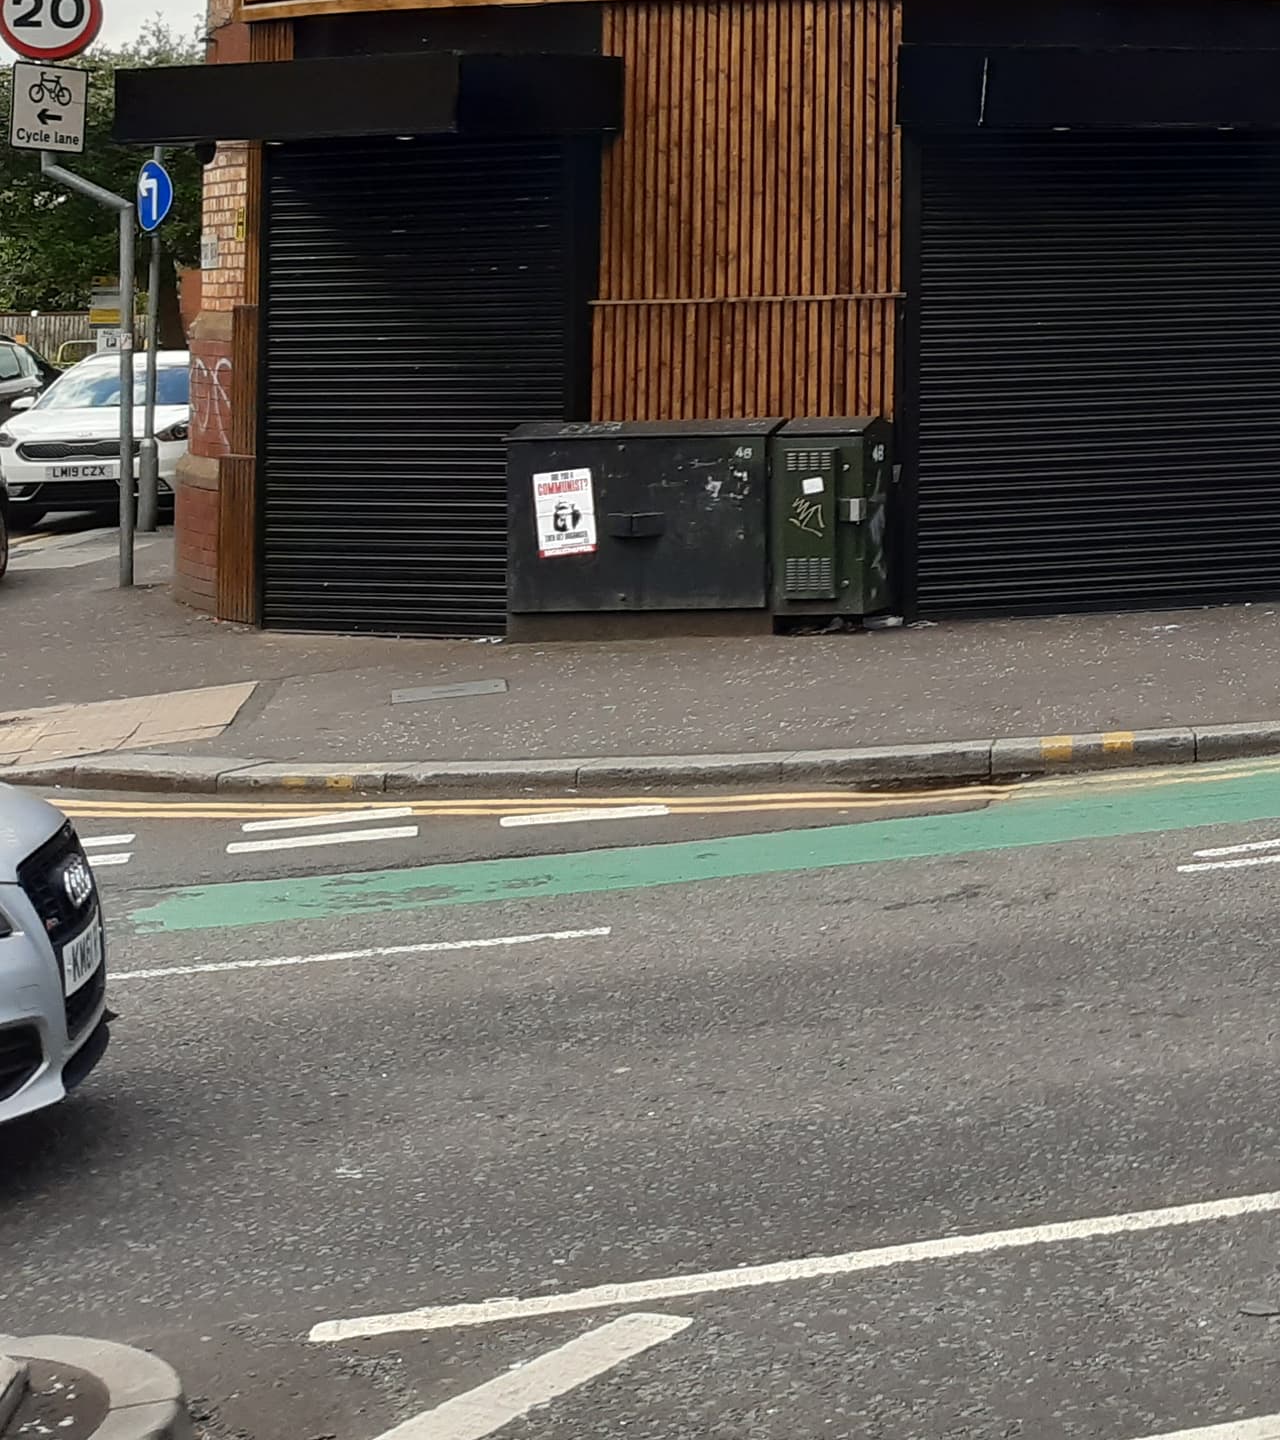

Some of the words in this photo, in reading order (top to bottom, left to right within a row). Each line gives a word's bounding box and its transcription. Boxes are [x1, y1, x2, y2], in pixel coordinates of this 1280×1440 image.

[16, 127, 51, 145] Cycle
[54, 130, 80, 146] lane
[52, 466, 79, 478] LM19
[82, 465, 105, 477] CZX
[537, 478, 588, 496] COMMUNIST?
